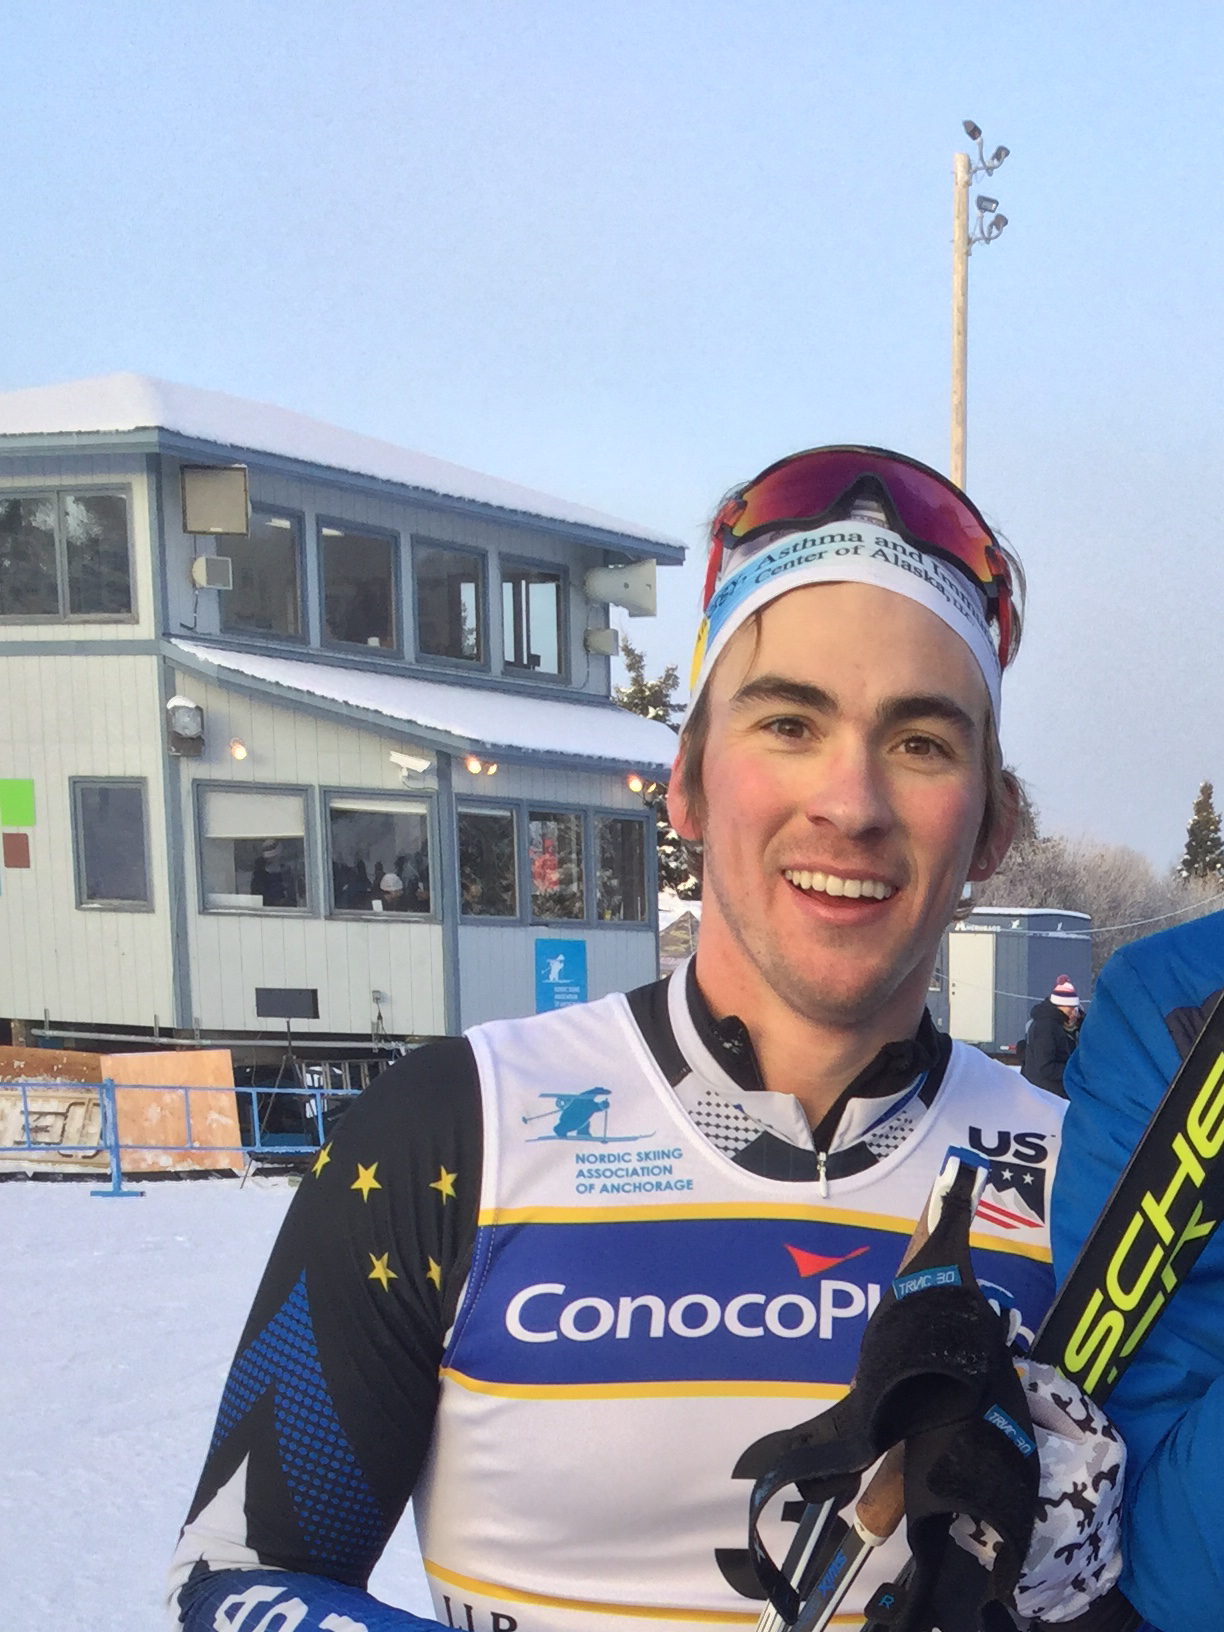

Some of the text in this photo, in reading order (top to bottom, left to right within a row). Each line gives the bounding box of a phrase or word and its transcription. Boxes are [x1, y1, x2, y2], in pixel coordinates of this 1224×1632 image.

[754, 531, 864, 572] Asthma
[875, 535, 924, 564] and
[754, 550, 828, 584] Center
[835, 544, 865, 557] of
[575, 1148, 683, 1165] NORDIC SKIING
[968, 1125, 1049, 1165] US
[575, 1164, 673, 1179] ASSOCIATION
[575, 1179, 694, 1194] OF ANCHORAGE
